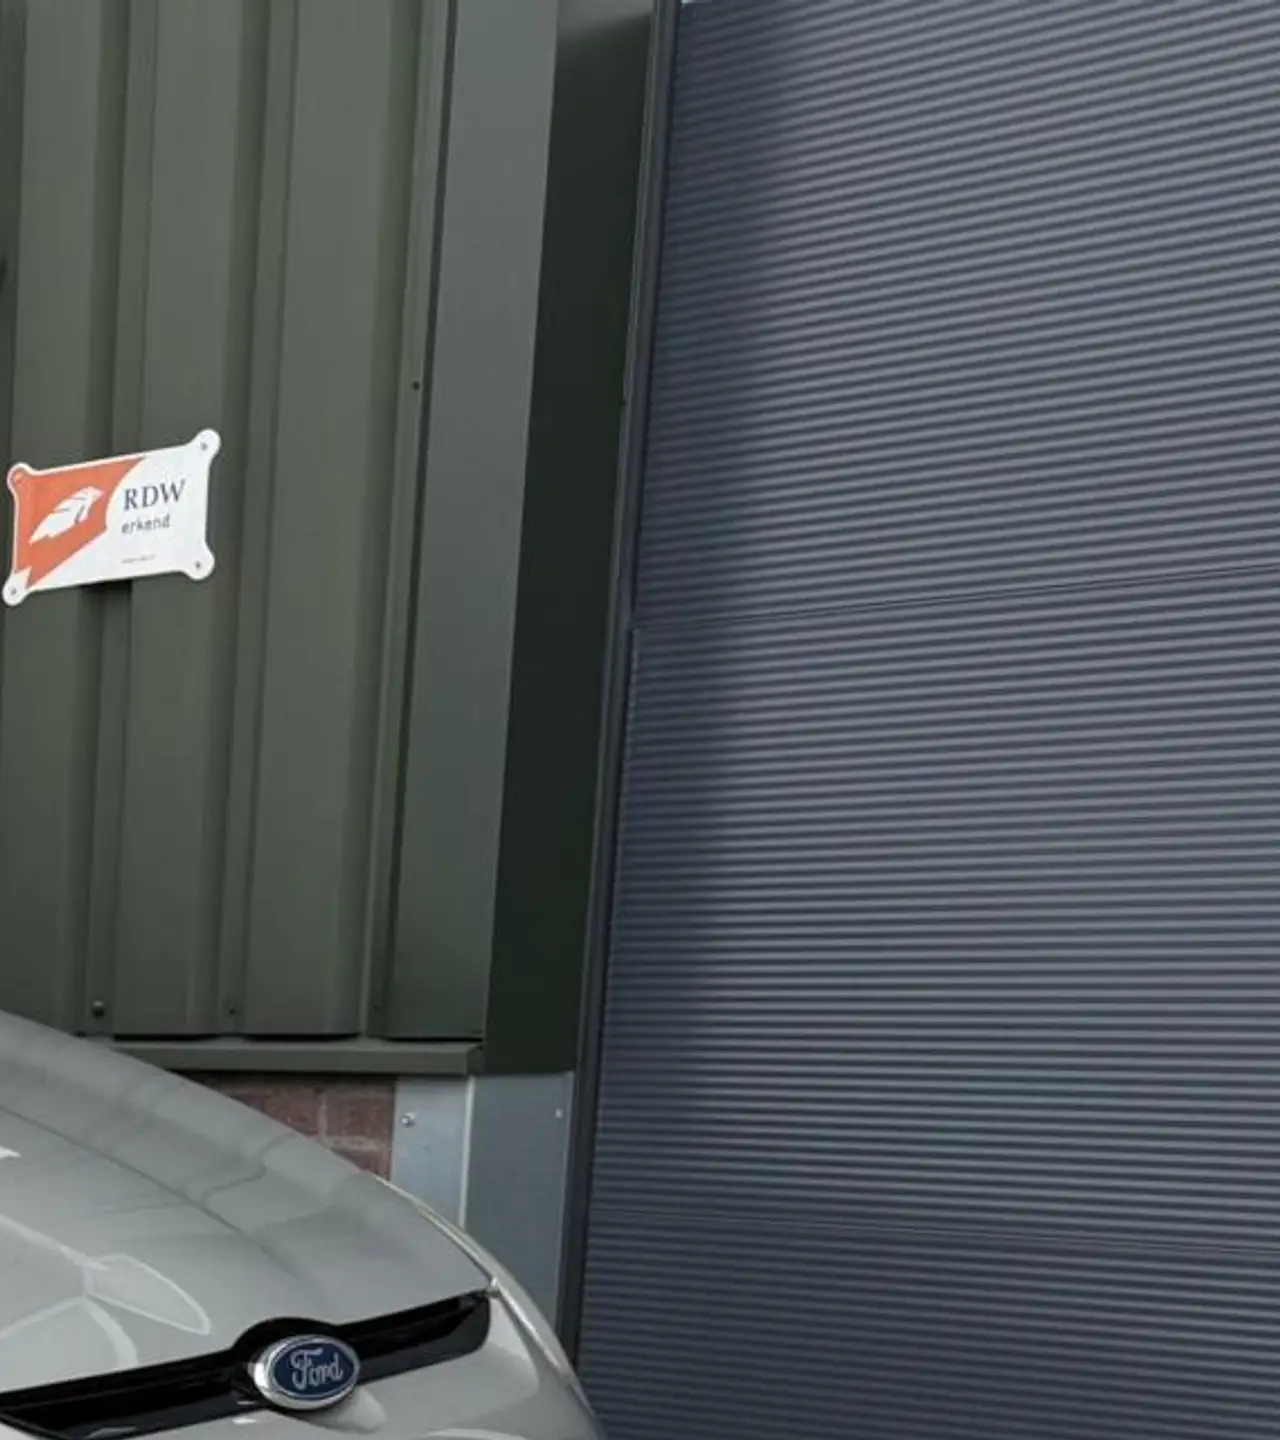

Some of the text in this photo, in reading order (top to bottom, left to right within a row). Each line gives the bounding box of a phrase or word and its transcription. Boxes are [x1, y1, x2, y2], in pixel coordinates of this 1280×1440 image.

[123, 479, 186, 511] RDW
[122, 514, 171, 534] erkend
[290, 1347, 344, 1391] Ford
